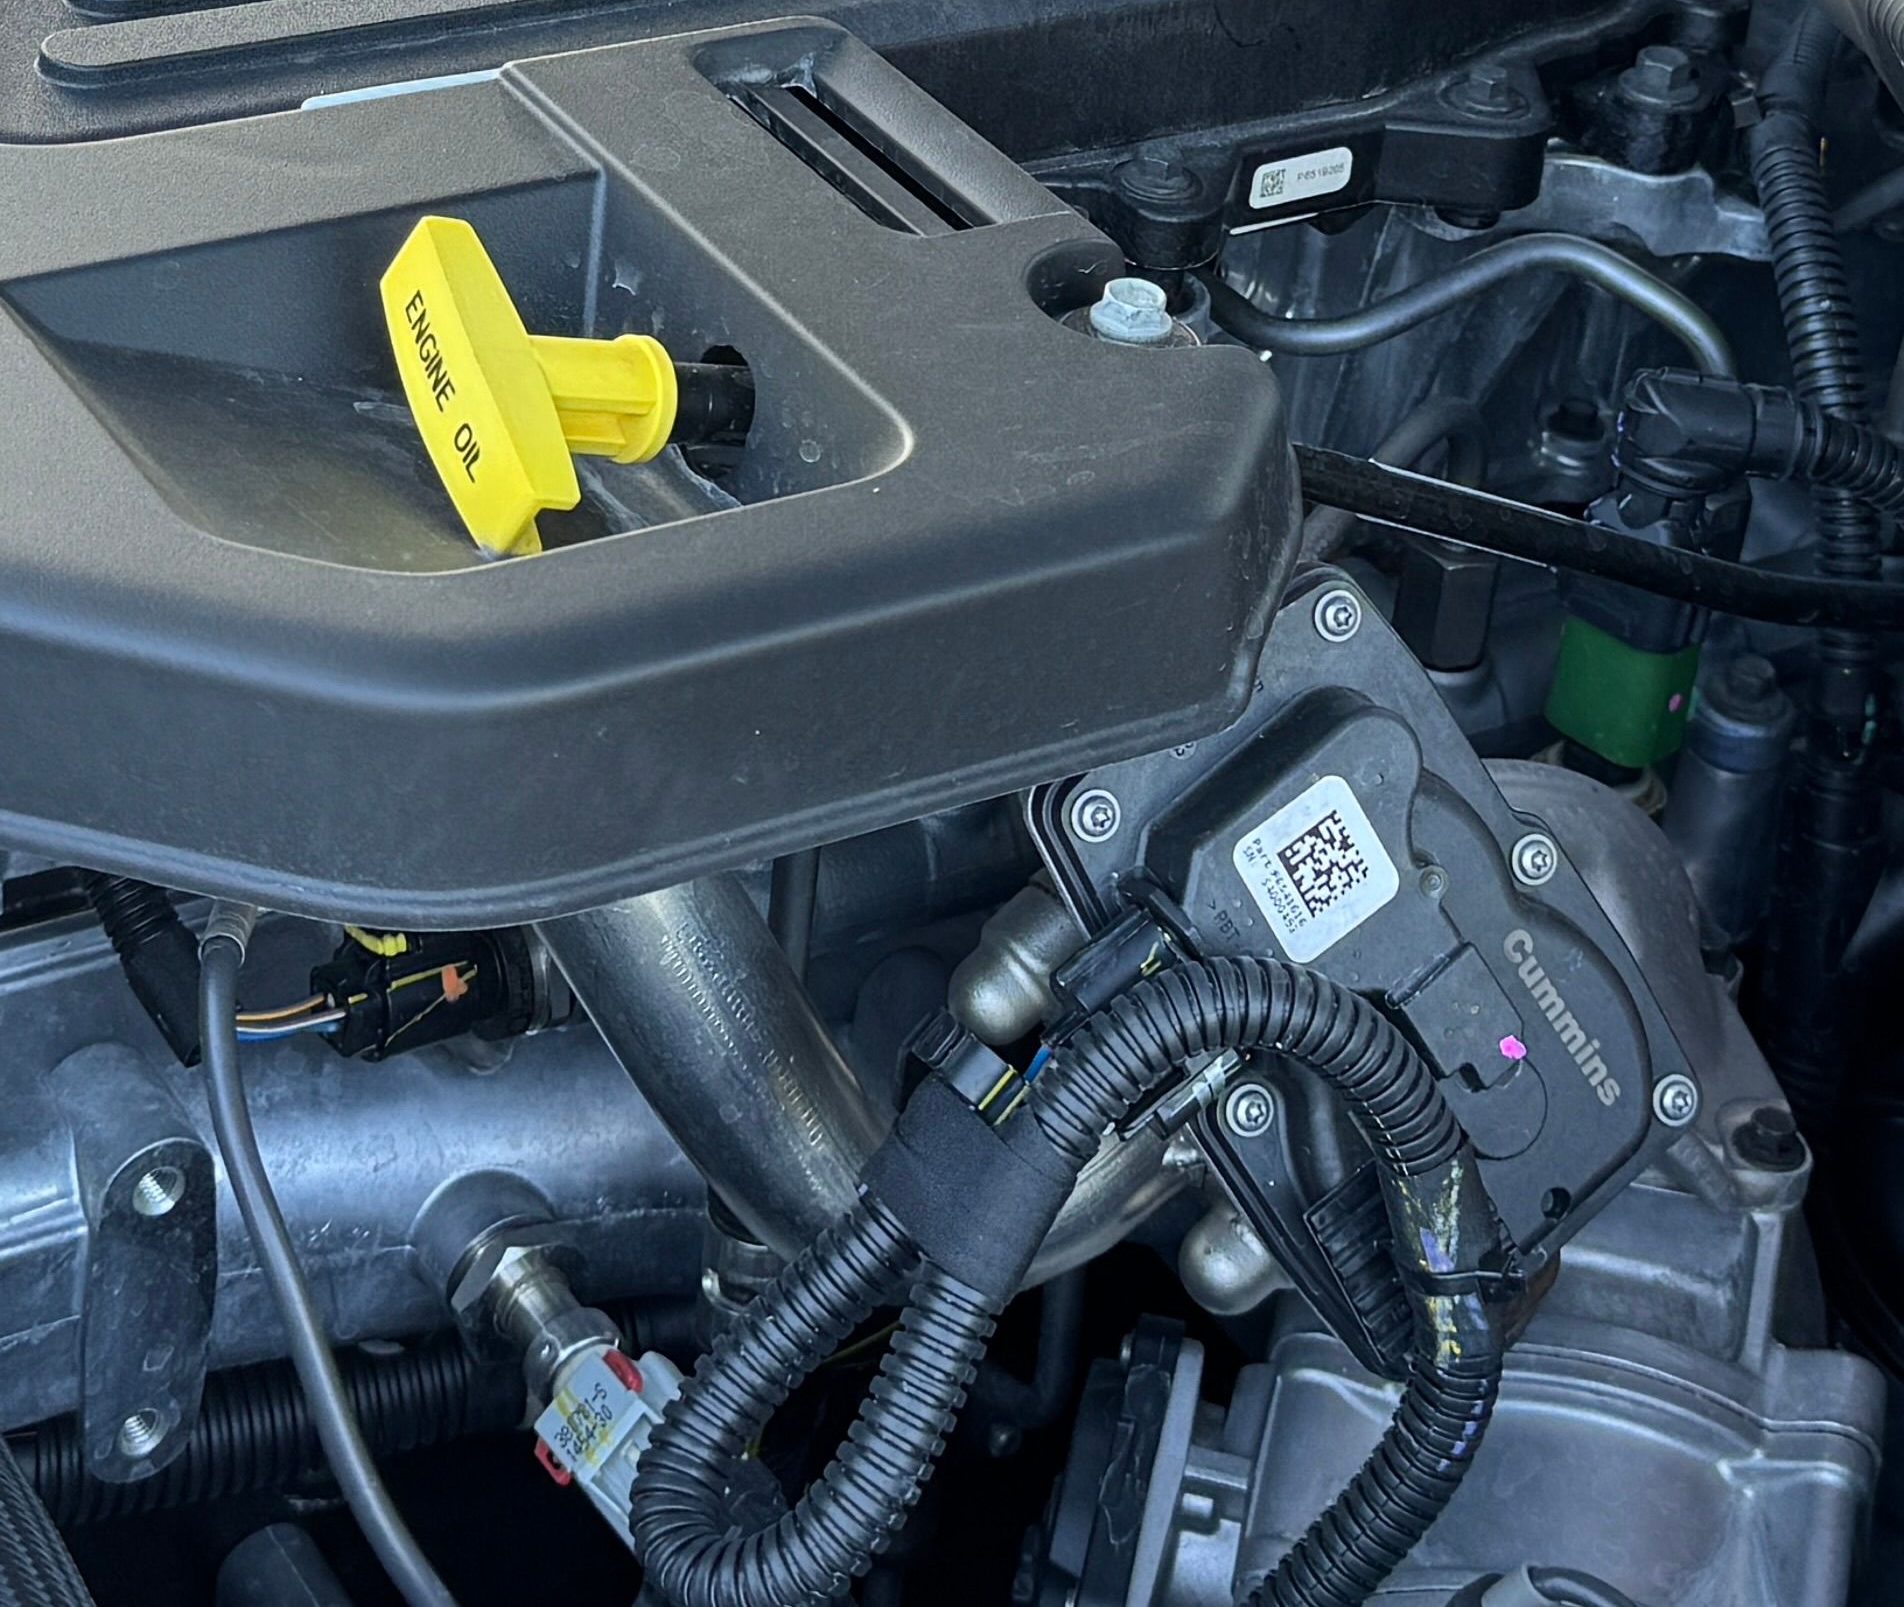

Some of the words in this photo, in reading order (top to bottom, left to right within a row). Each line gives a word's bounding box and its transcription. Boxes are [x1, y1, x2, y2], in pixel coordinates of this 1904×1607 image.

[406, 290, 456, 411] ENGINE
[454, 423, 482, 483] OIL
[1252, 837, 1272, 869] Part
[1502, 927, 1623, 1109] Cummins
